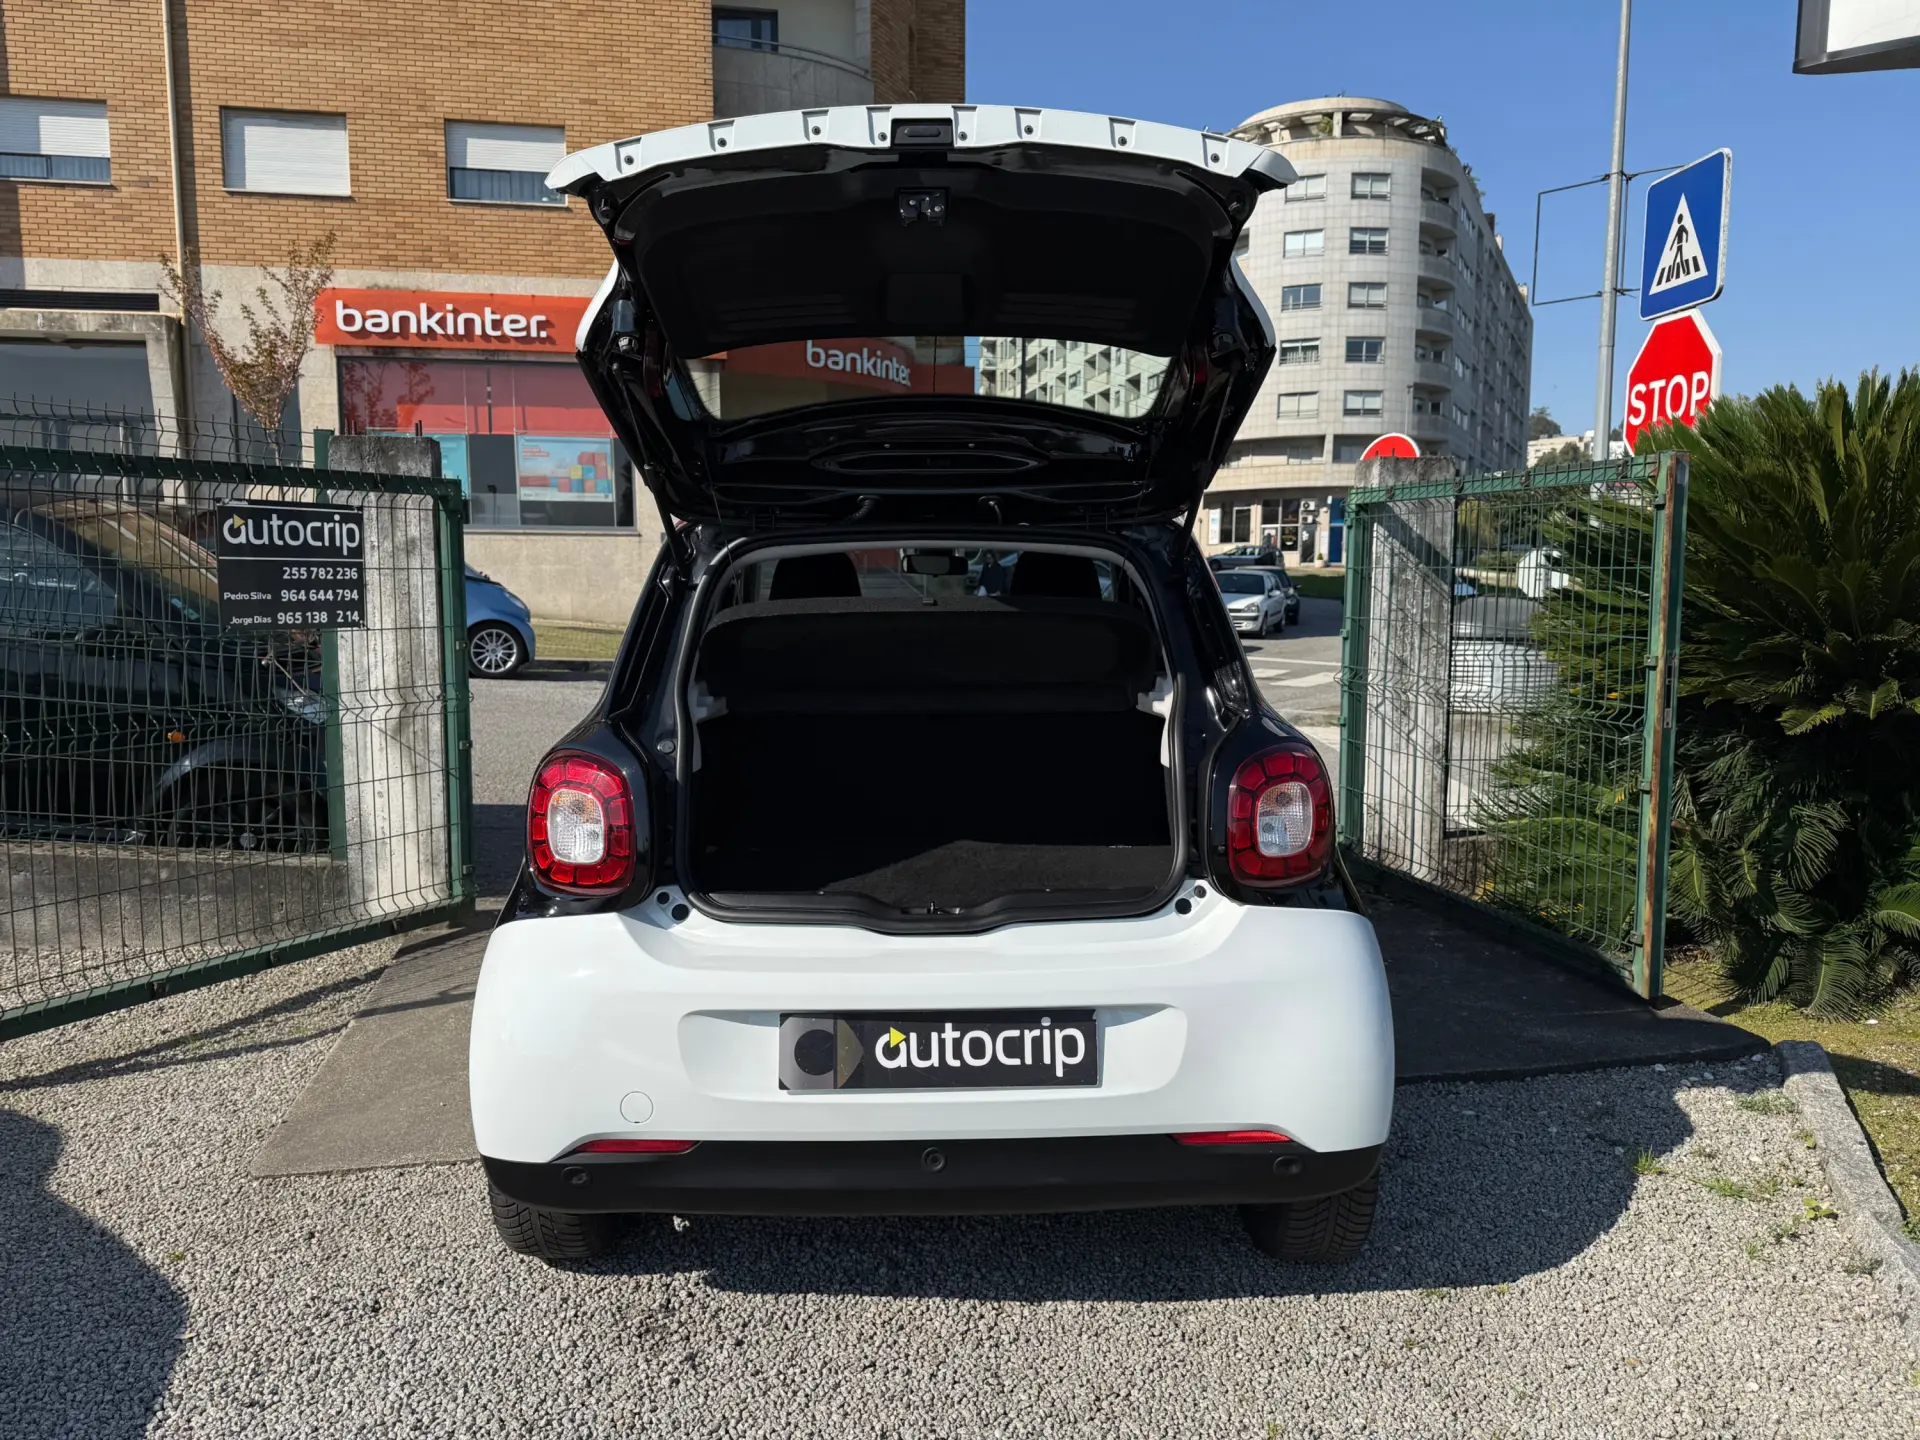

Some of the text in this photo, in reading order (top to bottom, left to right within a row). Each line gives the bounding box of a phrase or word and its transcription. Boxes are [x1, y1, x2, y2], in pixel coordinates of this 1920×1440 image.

[335, 300, 548, 339] bankinter.
[1628, 371, 1709, 426] STOP
[222, 513, 360, 556] autocrip
[282, 567, 358, 579] 255 782 236
[223, 590, 359, 602] Pedro Silva 964 644 794
[230, 610, 359, 626] Jorge Dias 965 138 214
[875, 1016, 1086, 1078] autocrip
